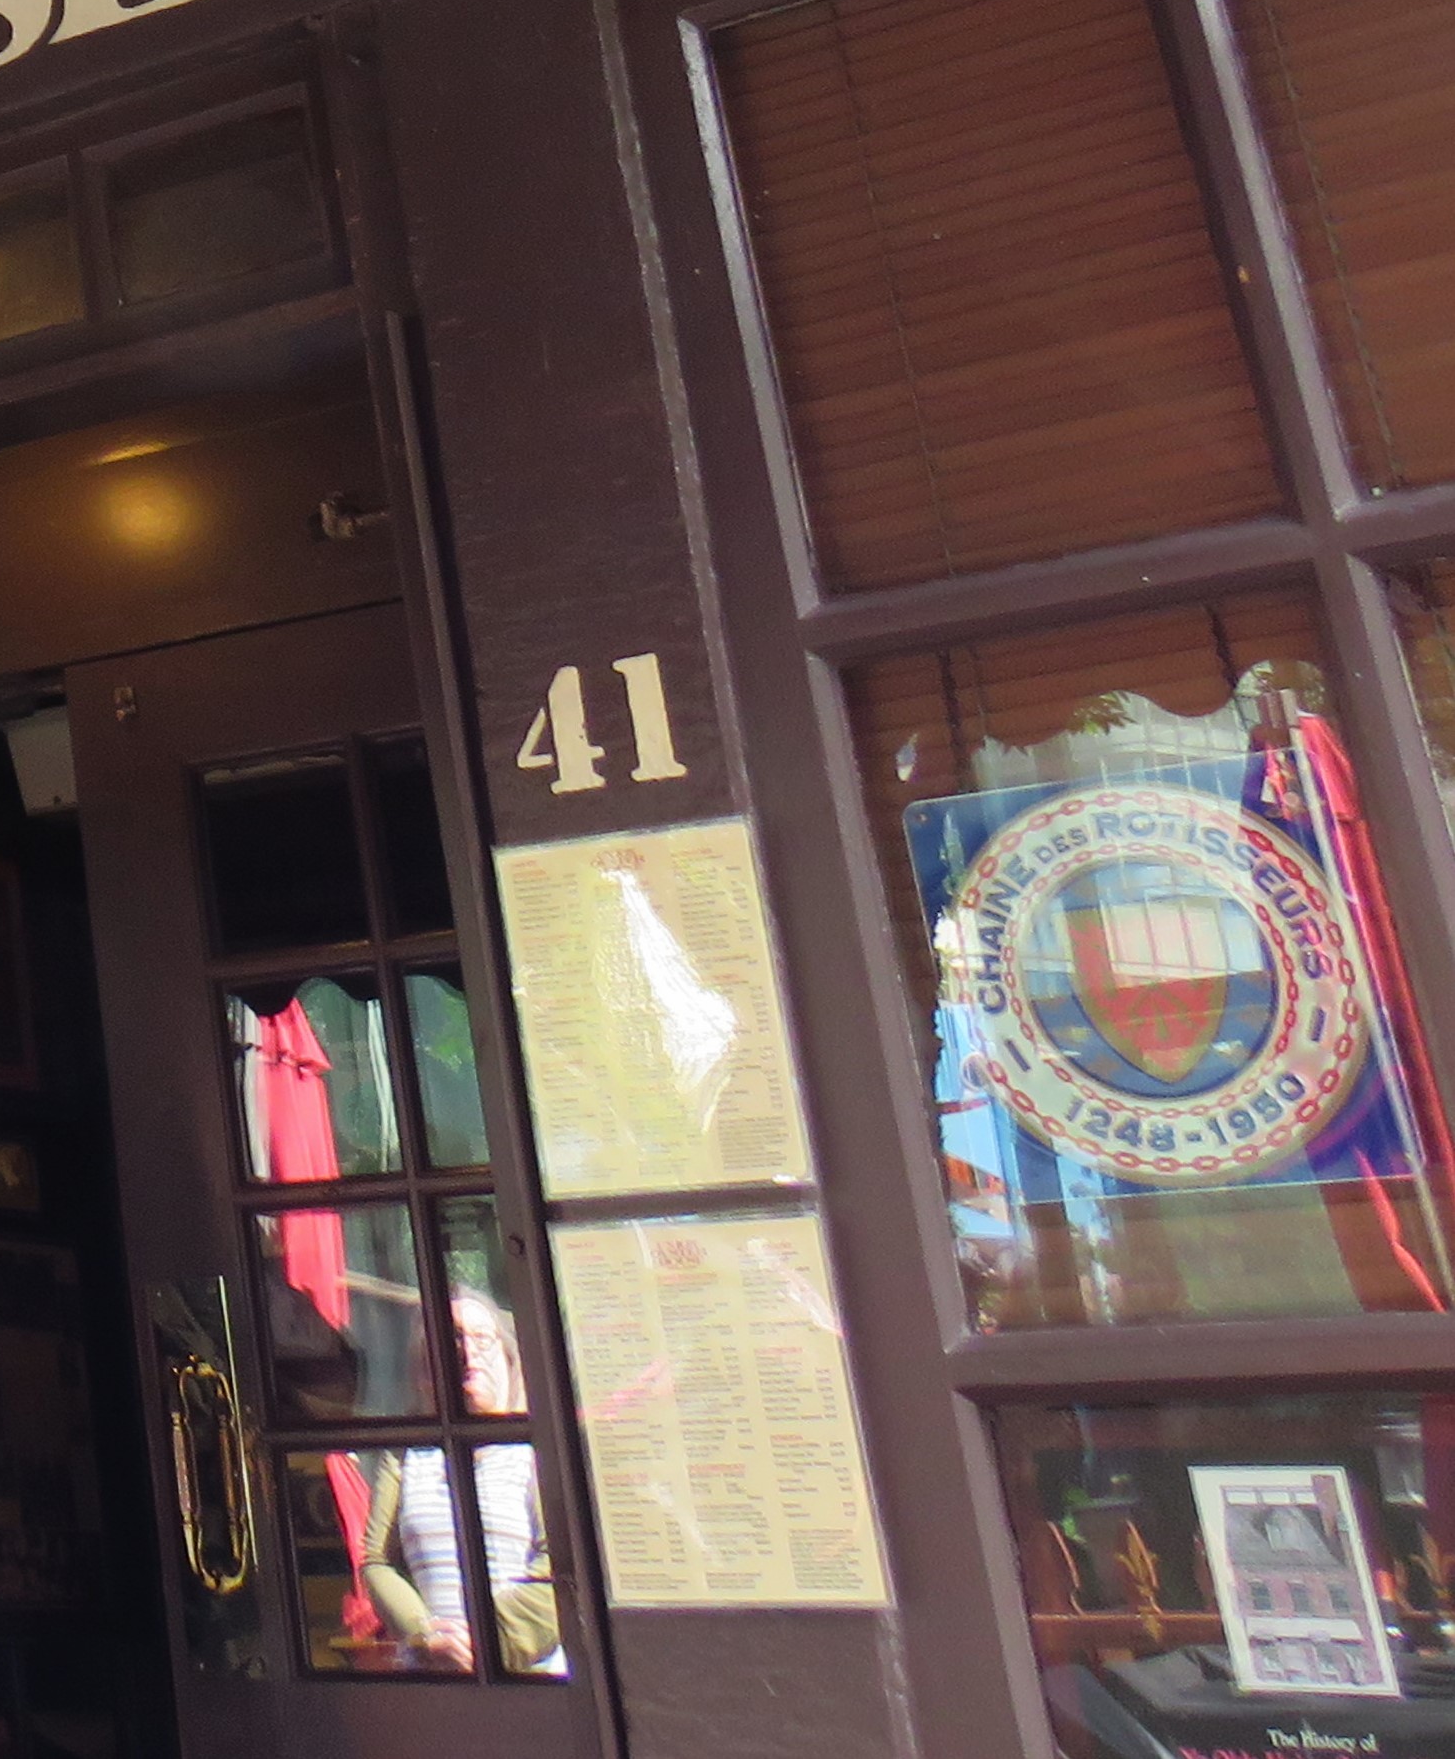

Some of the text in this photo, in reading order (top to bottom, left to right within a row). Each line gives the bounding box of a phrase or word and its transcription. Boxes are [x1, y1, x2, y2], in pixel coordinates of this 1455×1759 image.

[516, 652, 688, 795] 41
[976, 854, 1038, 1015] CHAINE
[1033, 826, 1089, 864] DES
[1093, 810, 1333, 980] ROTISSEURS
[1064, 1071, 1307, 1153] 1248-1950
